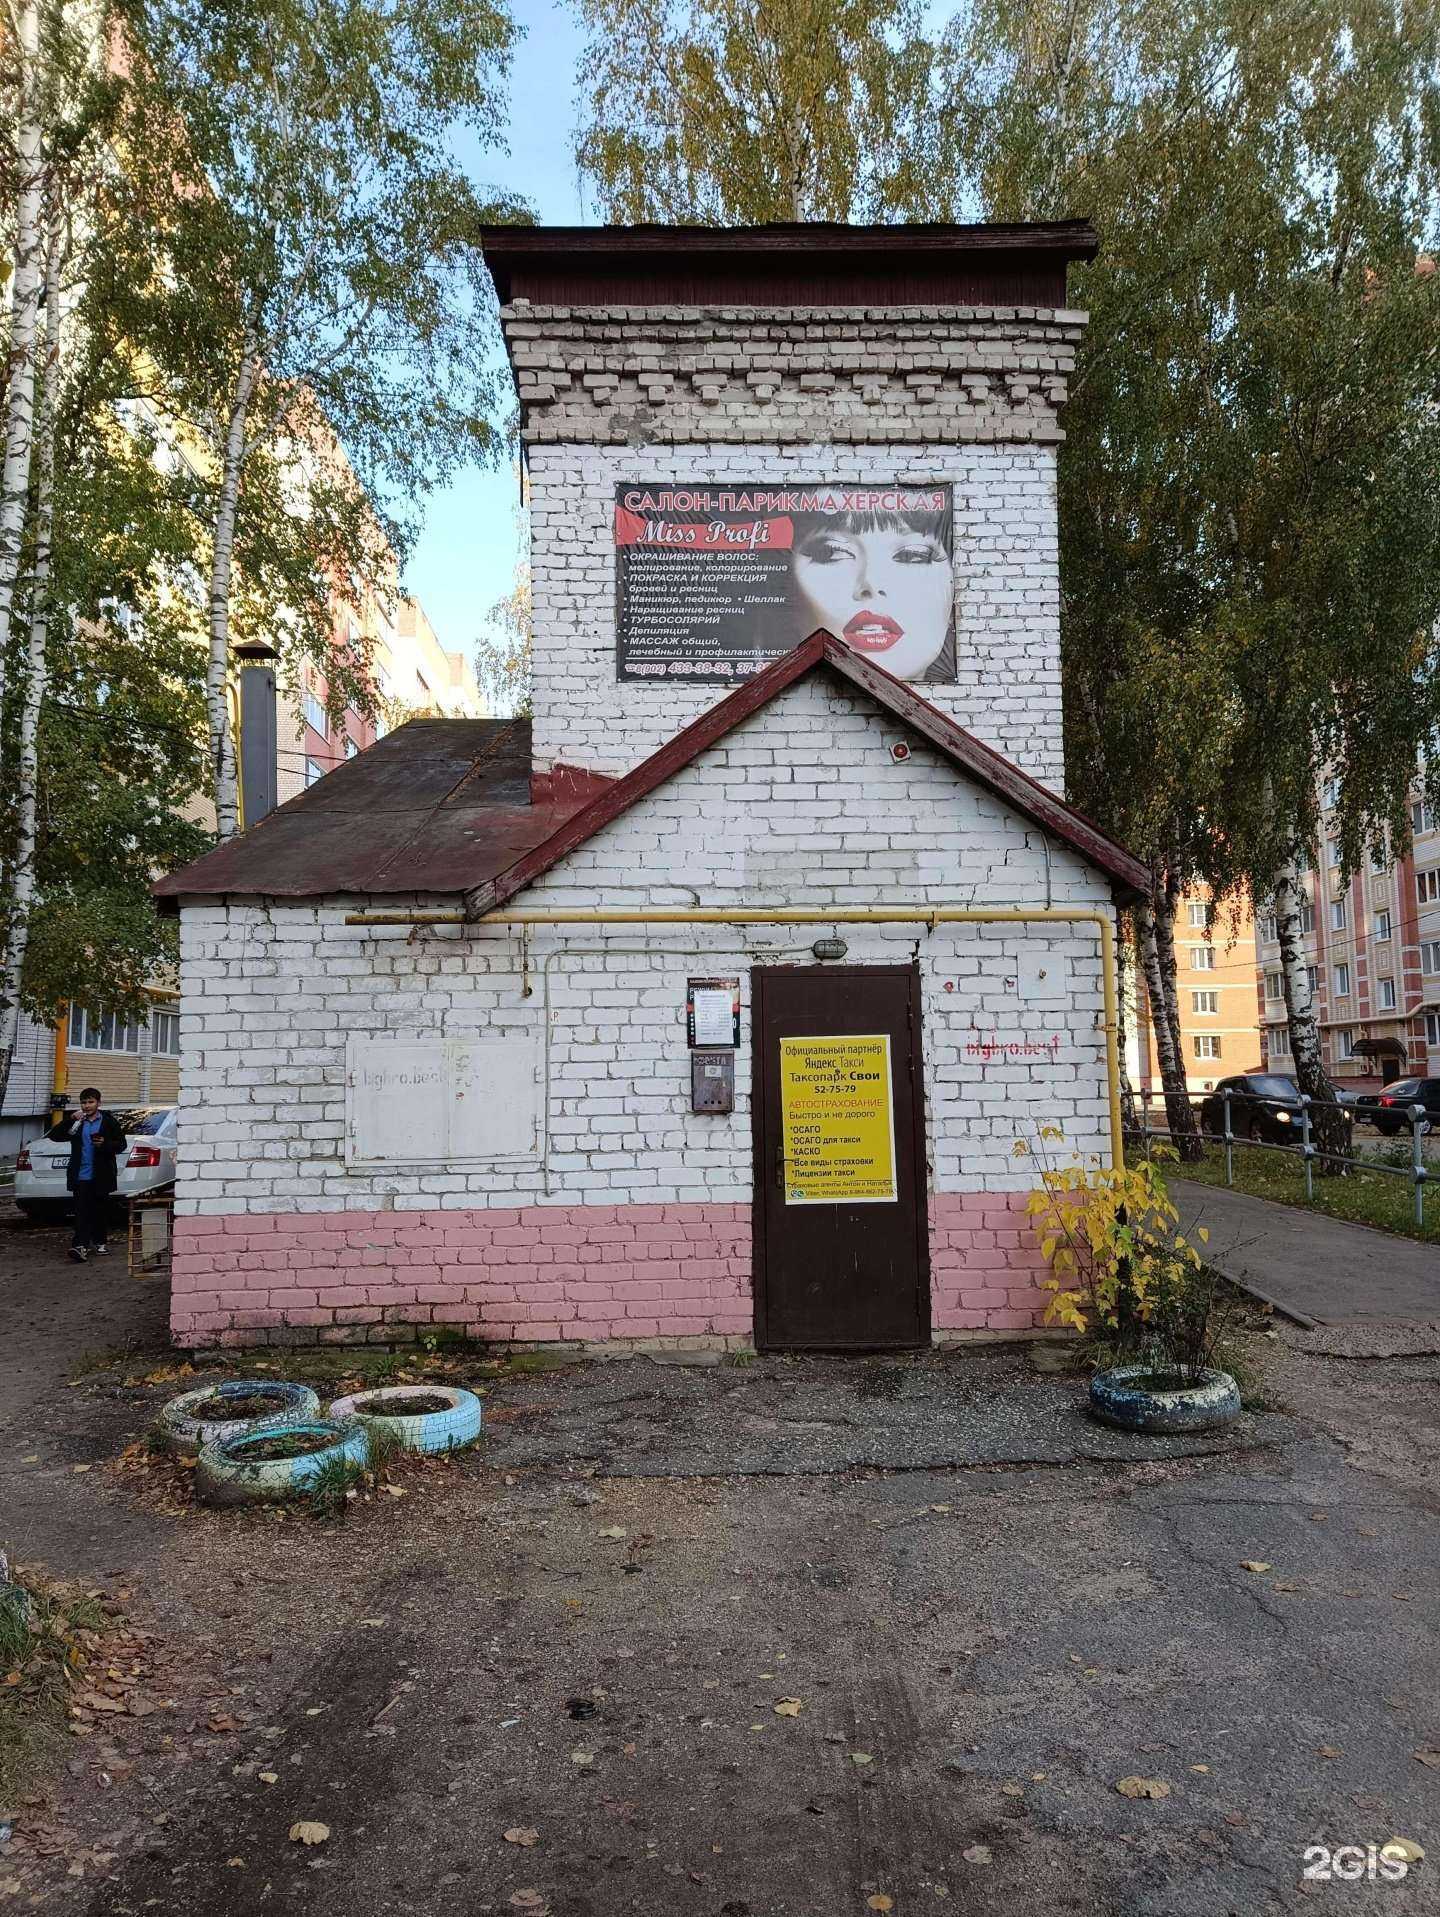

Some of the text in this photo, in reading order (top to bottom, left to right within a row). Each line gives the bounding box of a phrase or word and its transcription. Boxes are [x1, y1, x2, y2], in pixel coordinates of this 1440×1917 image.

[624, 491, 945, 512] САЛОН-ПАРИКМАХЕРСКАЯ
[636, 520, 770, 549] Miss Profi
[629, 553, 759, 561] ОКРАШИВАНИЕ ВОЛОС:
[629, 564, 788, 573] мелирование, колорирование
[629, 574, 767, 583] ПОКРАСКА И КОРРЕКЦИЯ
[629, 584, 668, 593] бровей
[629, 595, 786, 604] Маникюр, педикюр Шеллак
[629, 606, 745, 615] Наращивание ресниц
[630, 616, 720, 624] ТУРБОСОЛЯРИЙ
[629, 627, 689, 635] Депиляция
[629, 637, 721, 646] МАССАЖ общий,
[629, 648, 683, 656] лечебный
[668, 662, 734, 676] 433-38-32,
[785, 1044, 882, 1056] Официальный партнёр
[805, 1056, 864, 1069] Яндекс Такси
[789, 1071, 880, 1083] Таксопарк Свои
[814, 1085, 857, 1094] 52-75-79
[789, 1098, 885, 1109] АВТОСТРАХОВАНИЕ
[789, 1111, 822, 1120] Быстро
[845, 1110, 876, 1120] дорого
[793, 1125, 821, 1134] ОСАГО
[793, 1136, 821, 1145] ОСАГО
[823, 1137, 838, 1146] для
[793, 1147, 821, 1156] КАСКО
[811, 1159, 832, 1167] виды
[834, 1158, 874, 1167] страховки
[794, 1170, 832, 1178] Лицензии
